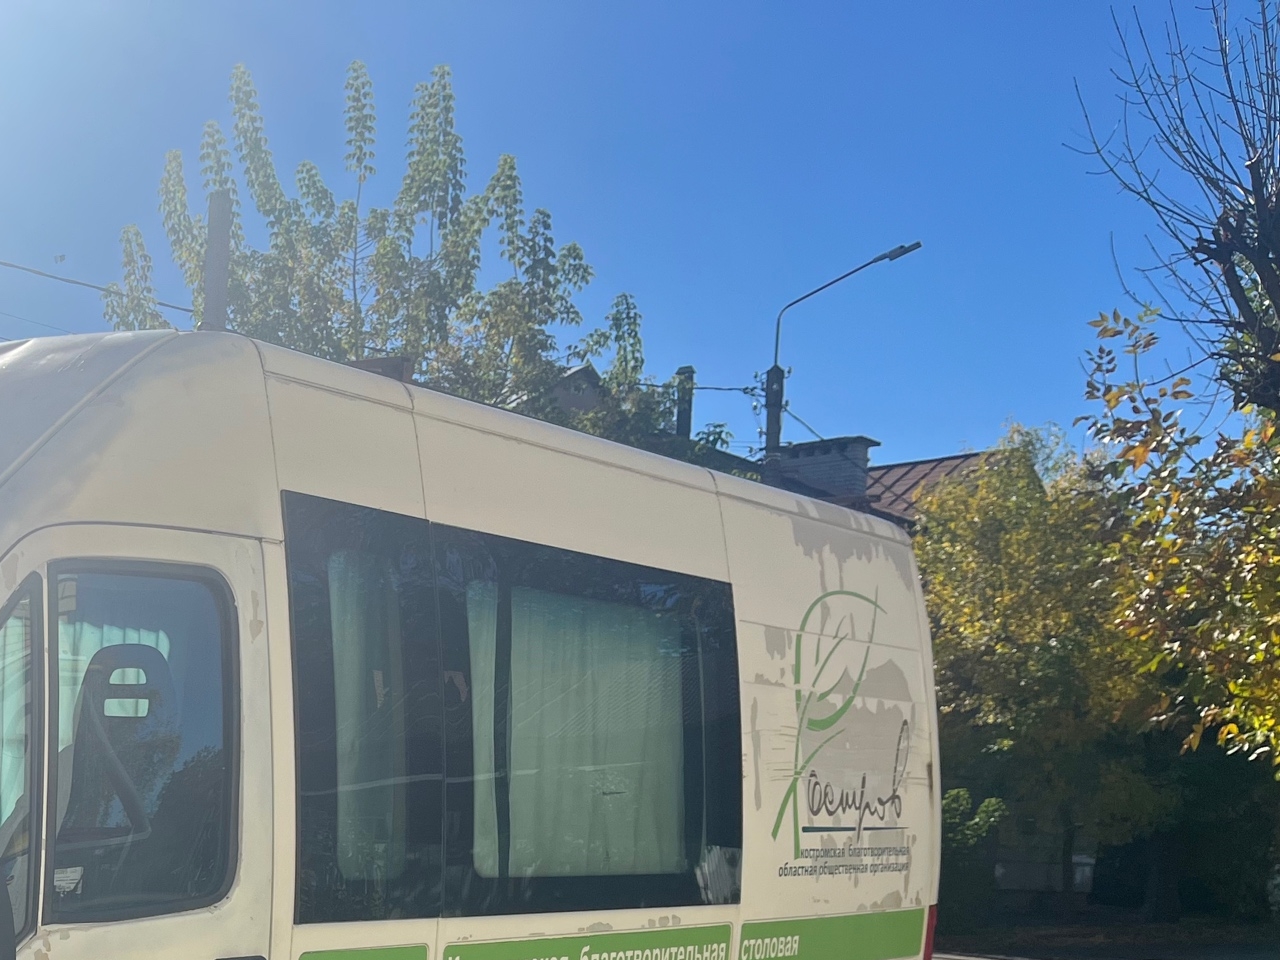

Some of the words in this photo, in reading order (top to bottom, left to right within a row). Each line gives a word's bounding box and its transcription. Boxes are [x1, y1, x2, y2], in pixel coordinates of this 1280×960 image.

[800, 847, 845, 862] костромская
[848, 844, 910, 861] благотворительная
[778, 862, 817, 877] областная
[819, 861, 868, 878] общественная
[870, 861, 909, 876] организация
